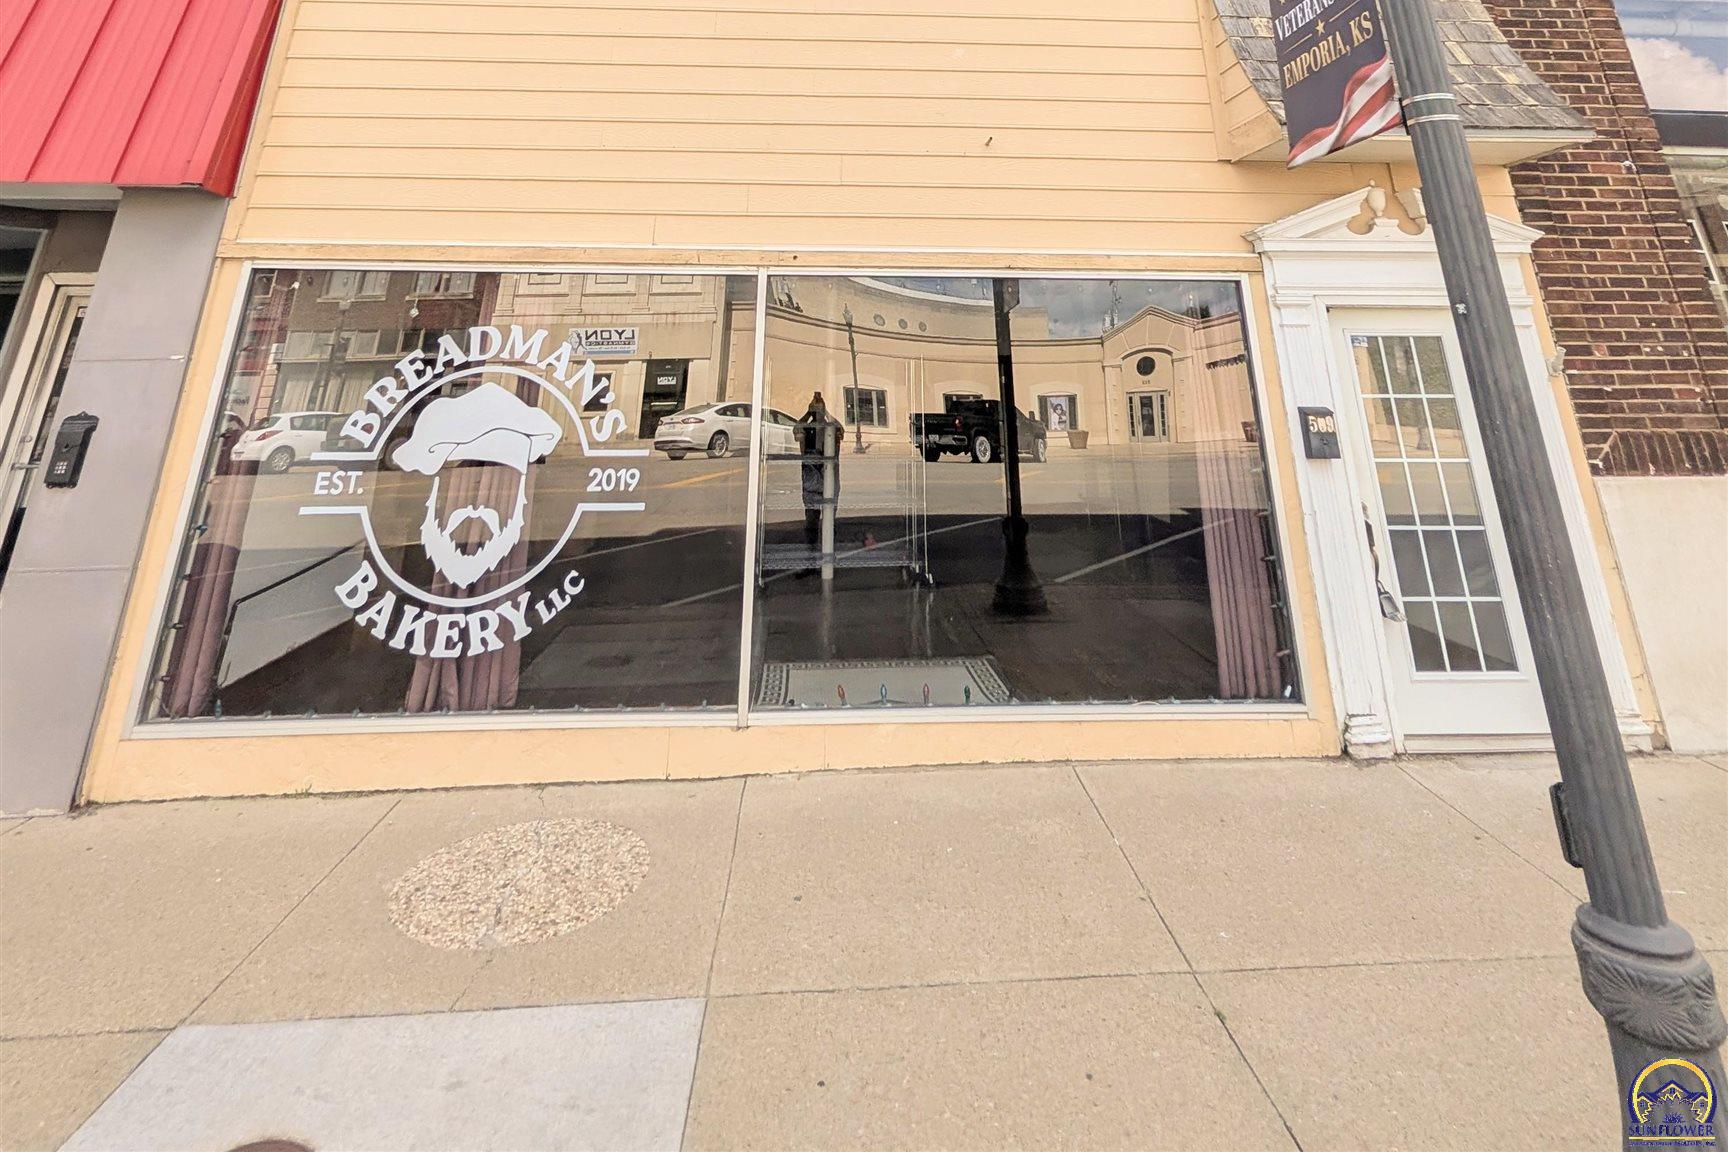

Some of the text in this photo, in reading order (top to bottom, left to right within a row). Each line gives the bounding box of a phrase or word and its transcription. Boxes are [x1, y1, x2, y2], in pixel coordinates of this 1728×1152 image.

[1283, 11, 1374, 89] EMPORIA, KS
[340, 324, 628, 449] BREADMAN'S
[314, 468, 641, 495] EST. 2019
[335, 560, 586, 659] BAKERY LLC
